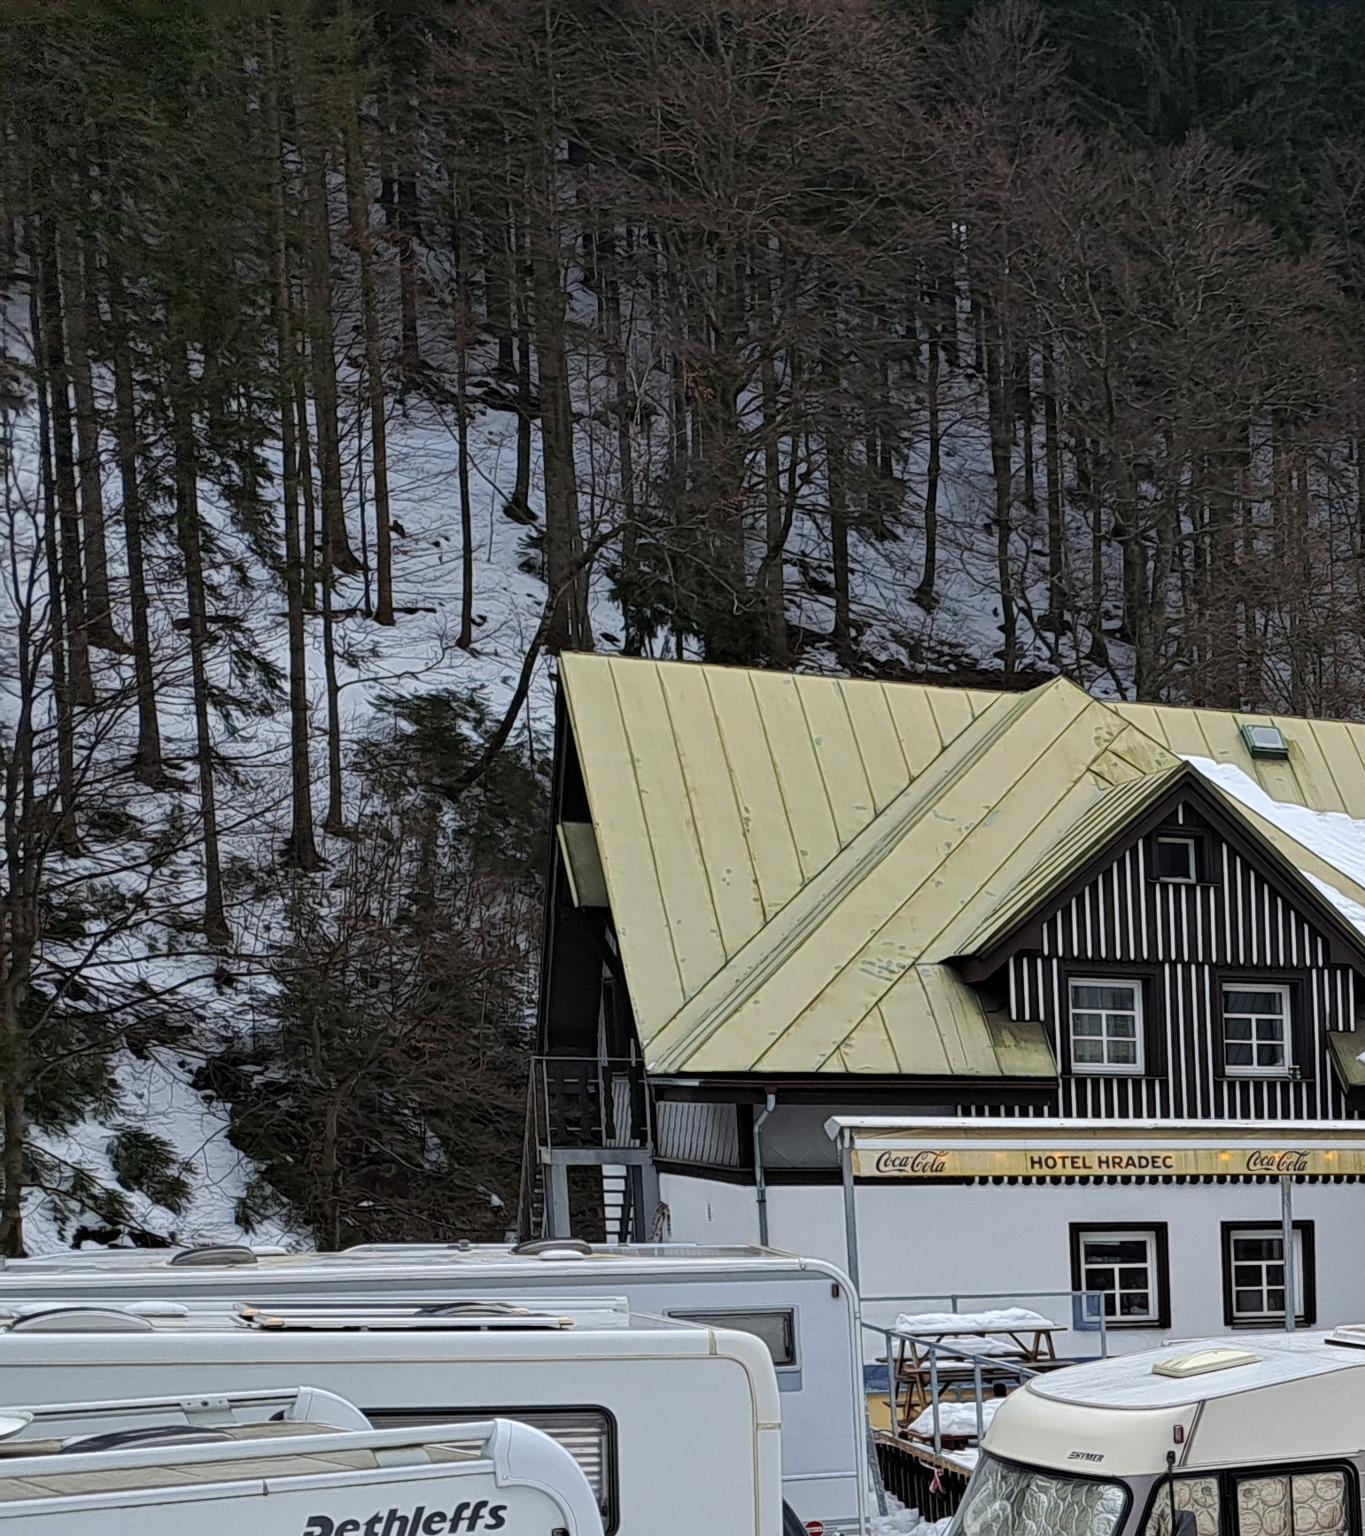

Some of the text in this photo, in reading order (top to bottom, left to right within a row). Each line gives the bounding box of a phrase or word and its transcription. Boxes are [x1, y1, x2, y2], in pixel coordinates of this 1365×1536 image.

[876, 1151, 949, 1173] Coca-Cola
[1030, 1155, 1174, 1169] HOTEL HRADEC
[1246, 1151, 1310, 1172] Coca-Cola
